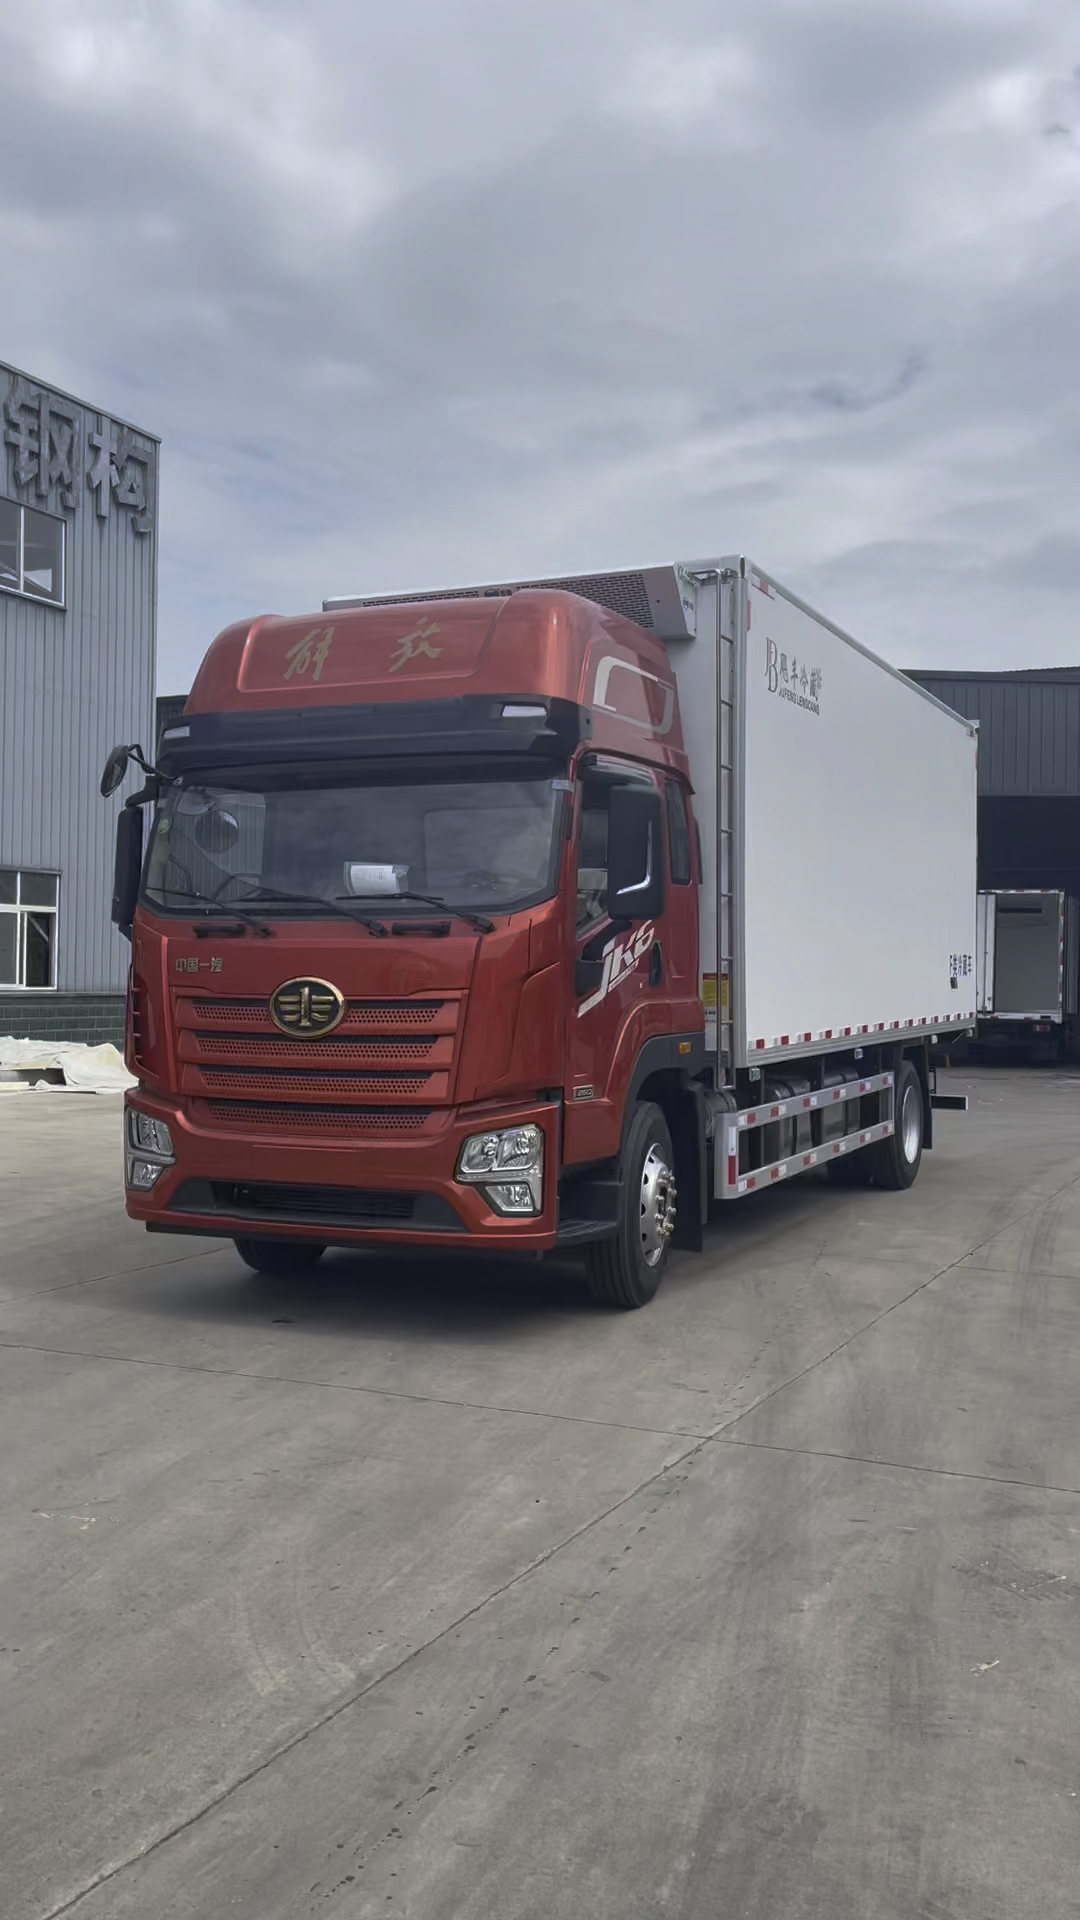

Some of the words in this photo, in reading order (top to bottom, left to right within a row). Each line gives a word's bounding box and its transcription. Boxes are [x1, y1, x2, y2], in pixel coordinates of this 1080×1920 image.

[3, 374, 153, 533] 钢构
[283, 616, 444, 682] 解放
[175, 957, 224, 973] 中国一汽
[577, 919, 655, 1018] JK6
